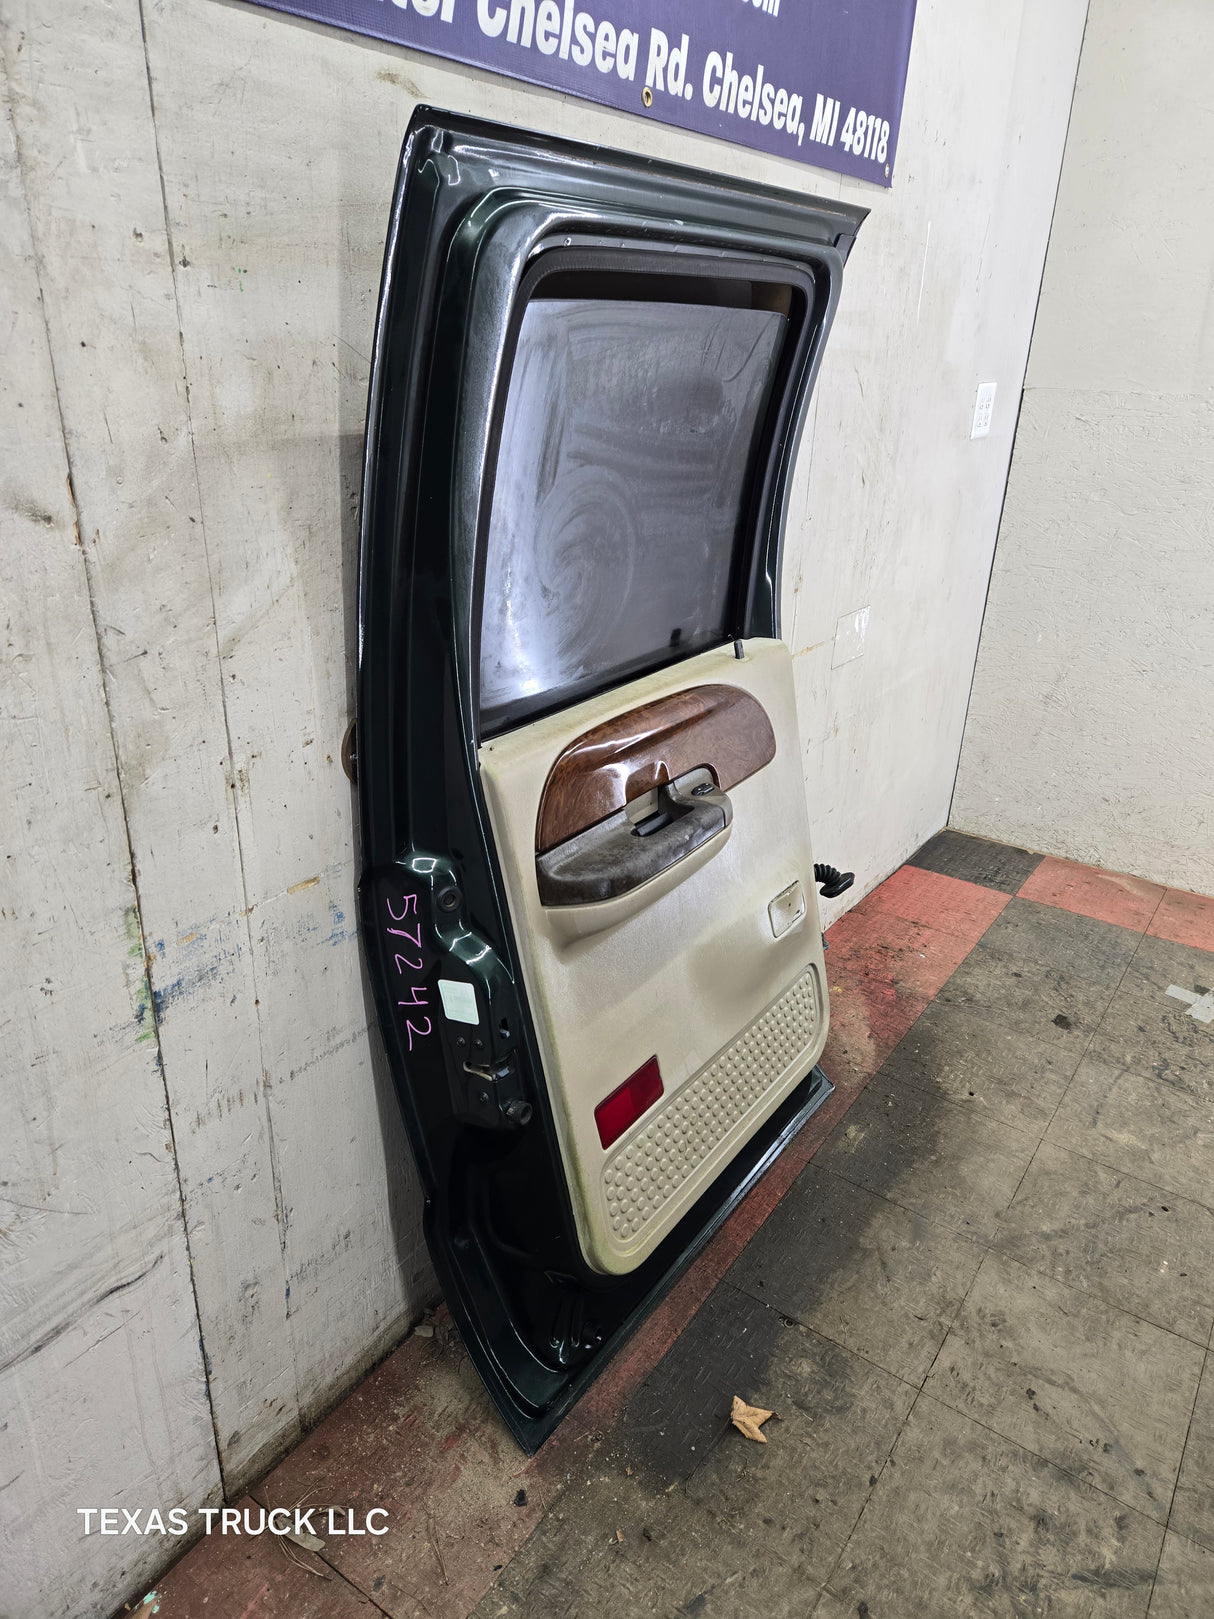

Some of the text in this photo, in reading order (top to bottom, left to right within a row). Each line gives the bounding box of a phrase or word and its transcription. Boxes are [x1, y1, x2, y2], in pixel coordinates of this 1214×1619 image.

[477, 0, 890, 164] Chelsea Rd. Chelsea, MI 48118
[387, 894, 432, 1051] 57242
